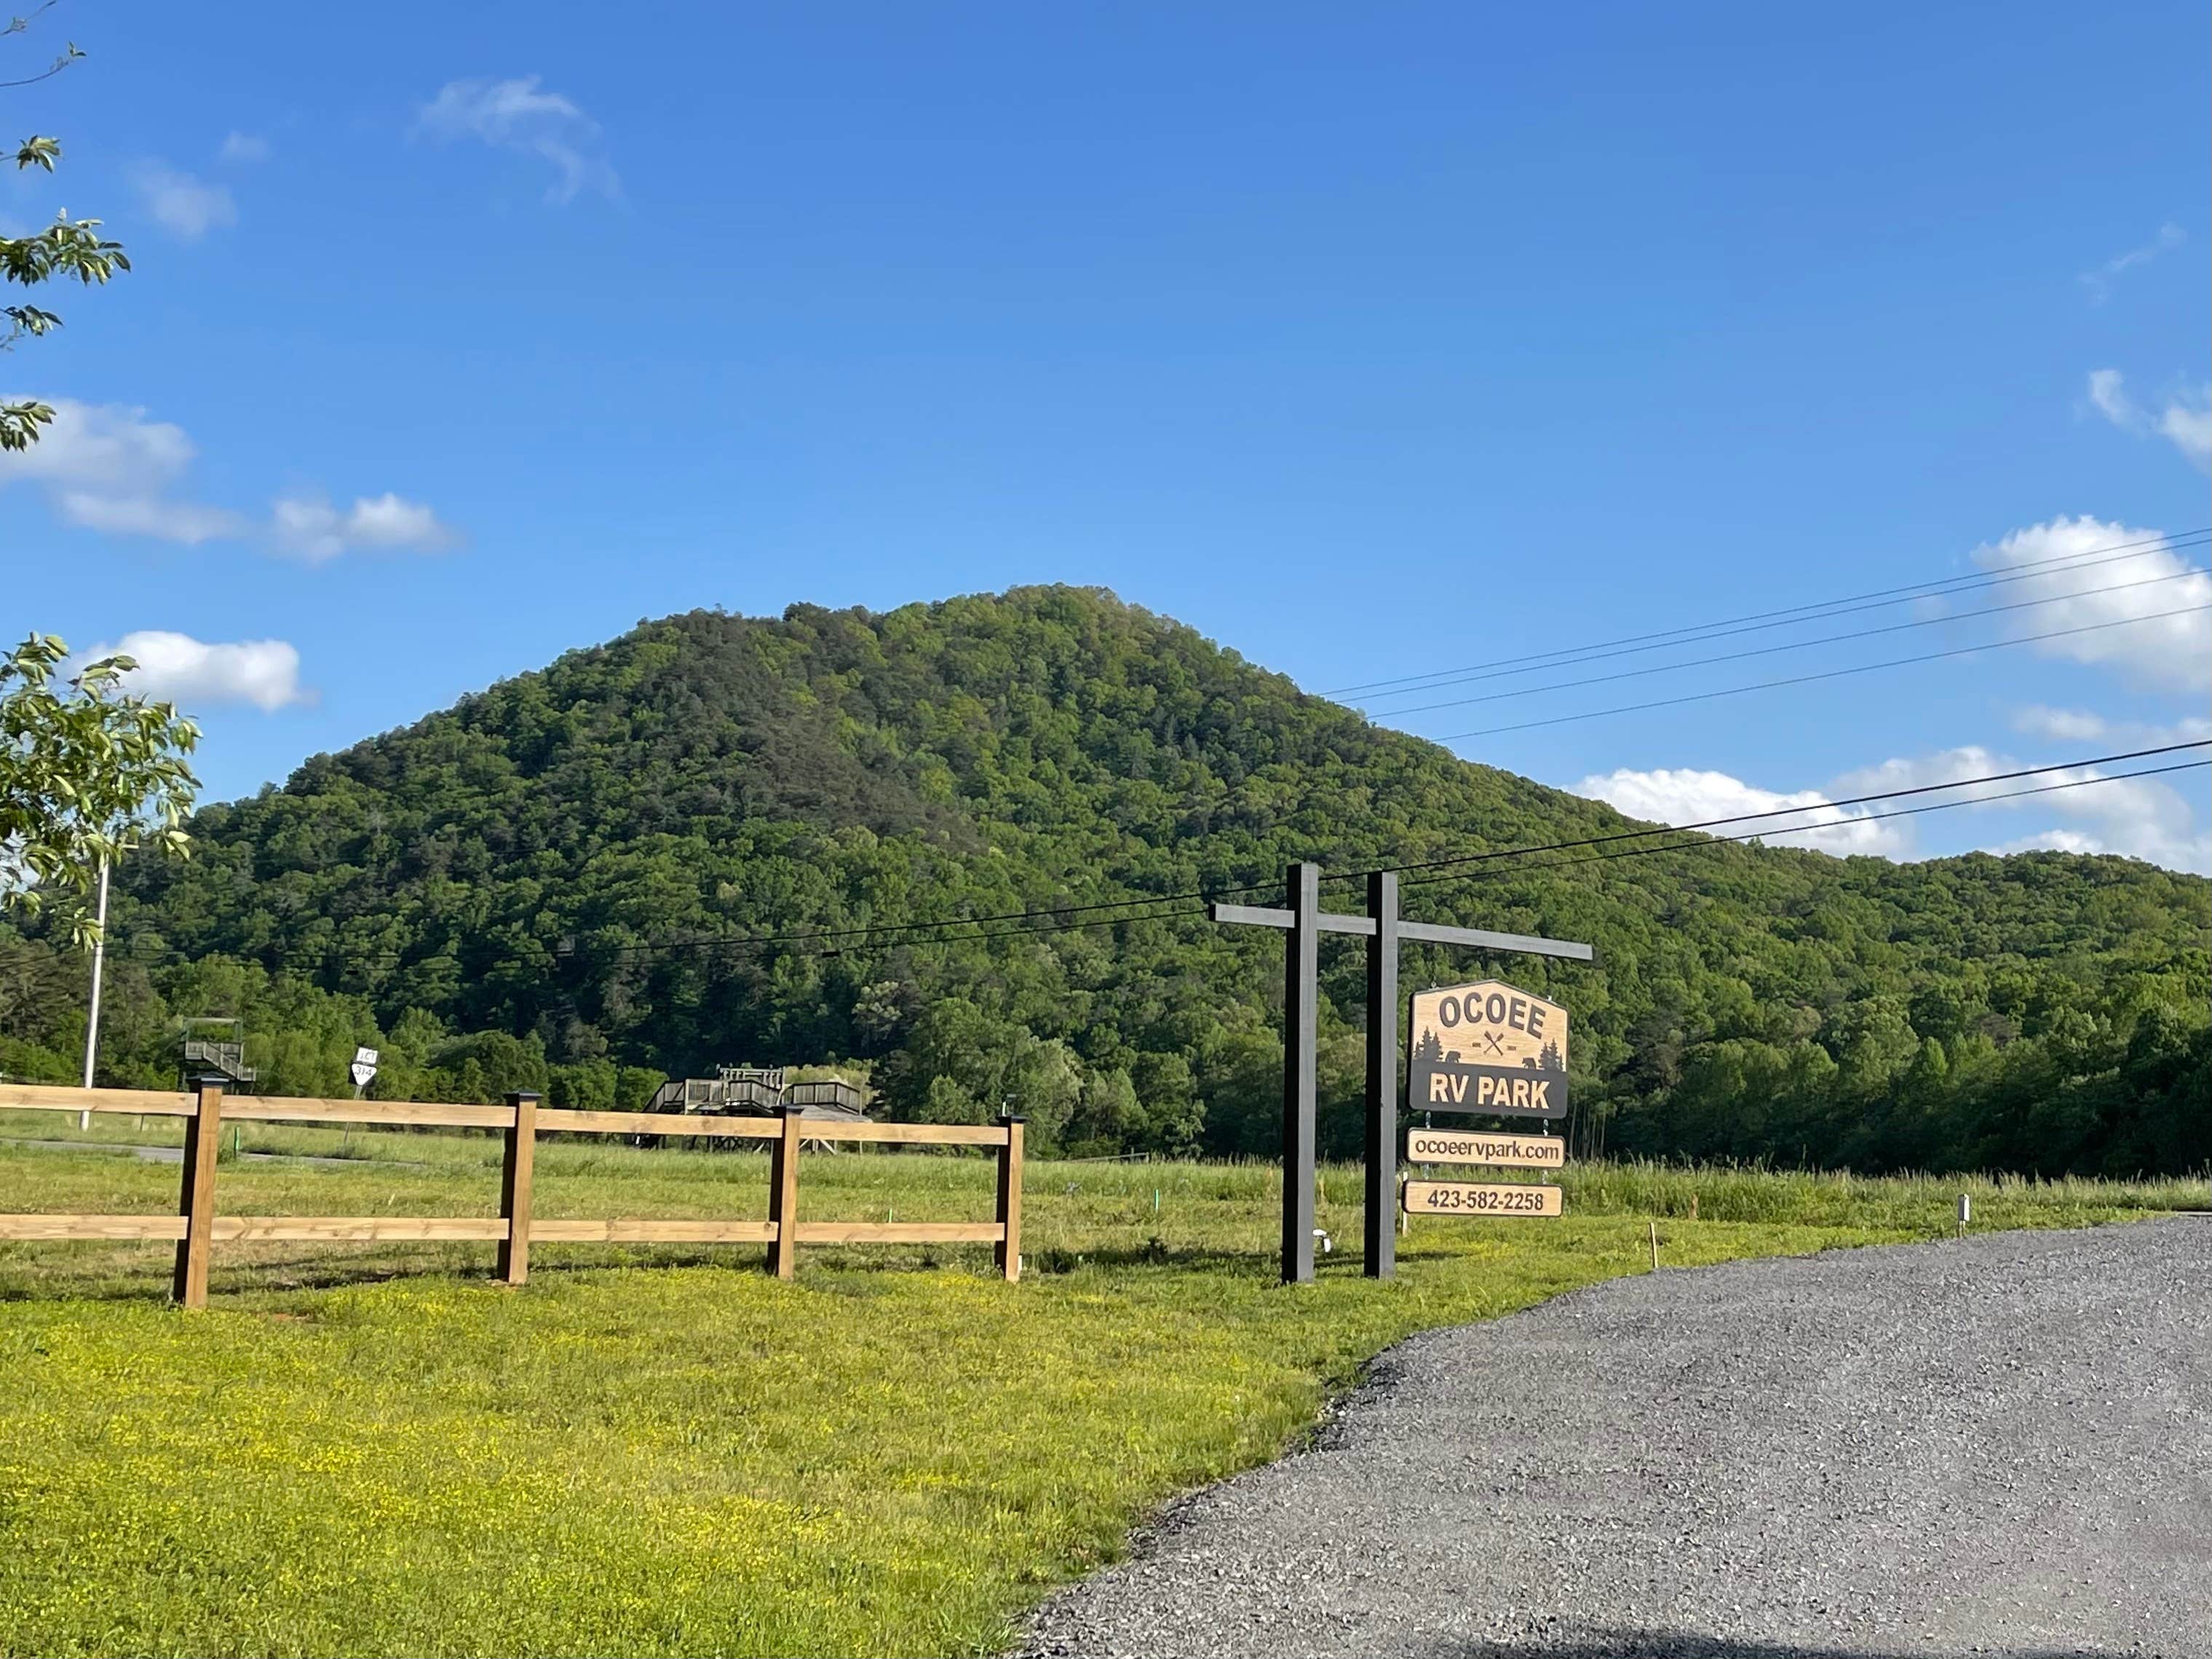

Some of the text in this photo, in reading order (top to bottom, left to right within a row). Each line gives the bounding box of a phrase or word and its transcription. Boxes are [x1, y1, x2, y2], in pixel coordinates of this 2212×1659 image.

[1439, 992, 1546, 1040] OCOEE
[354, 1066, 372, 1076] 314
[1430, 1072, 1550, 1109] RV PARK
[1416, 1140, 1558, 1160] ocoeervpark.com
[1427, 1189, 1544, 1210] 423-582-2258
